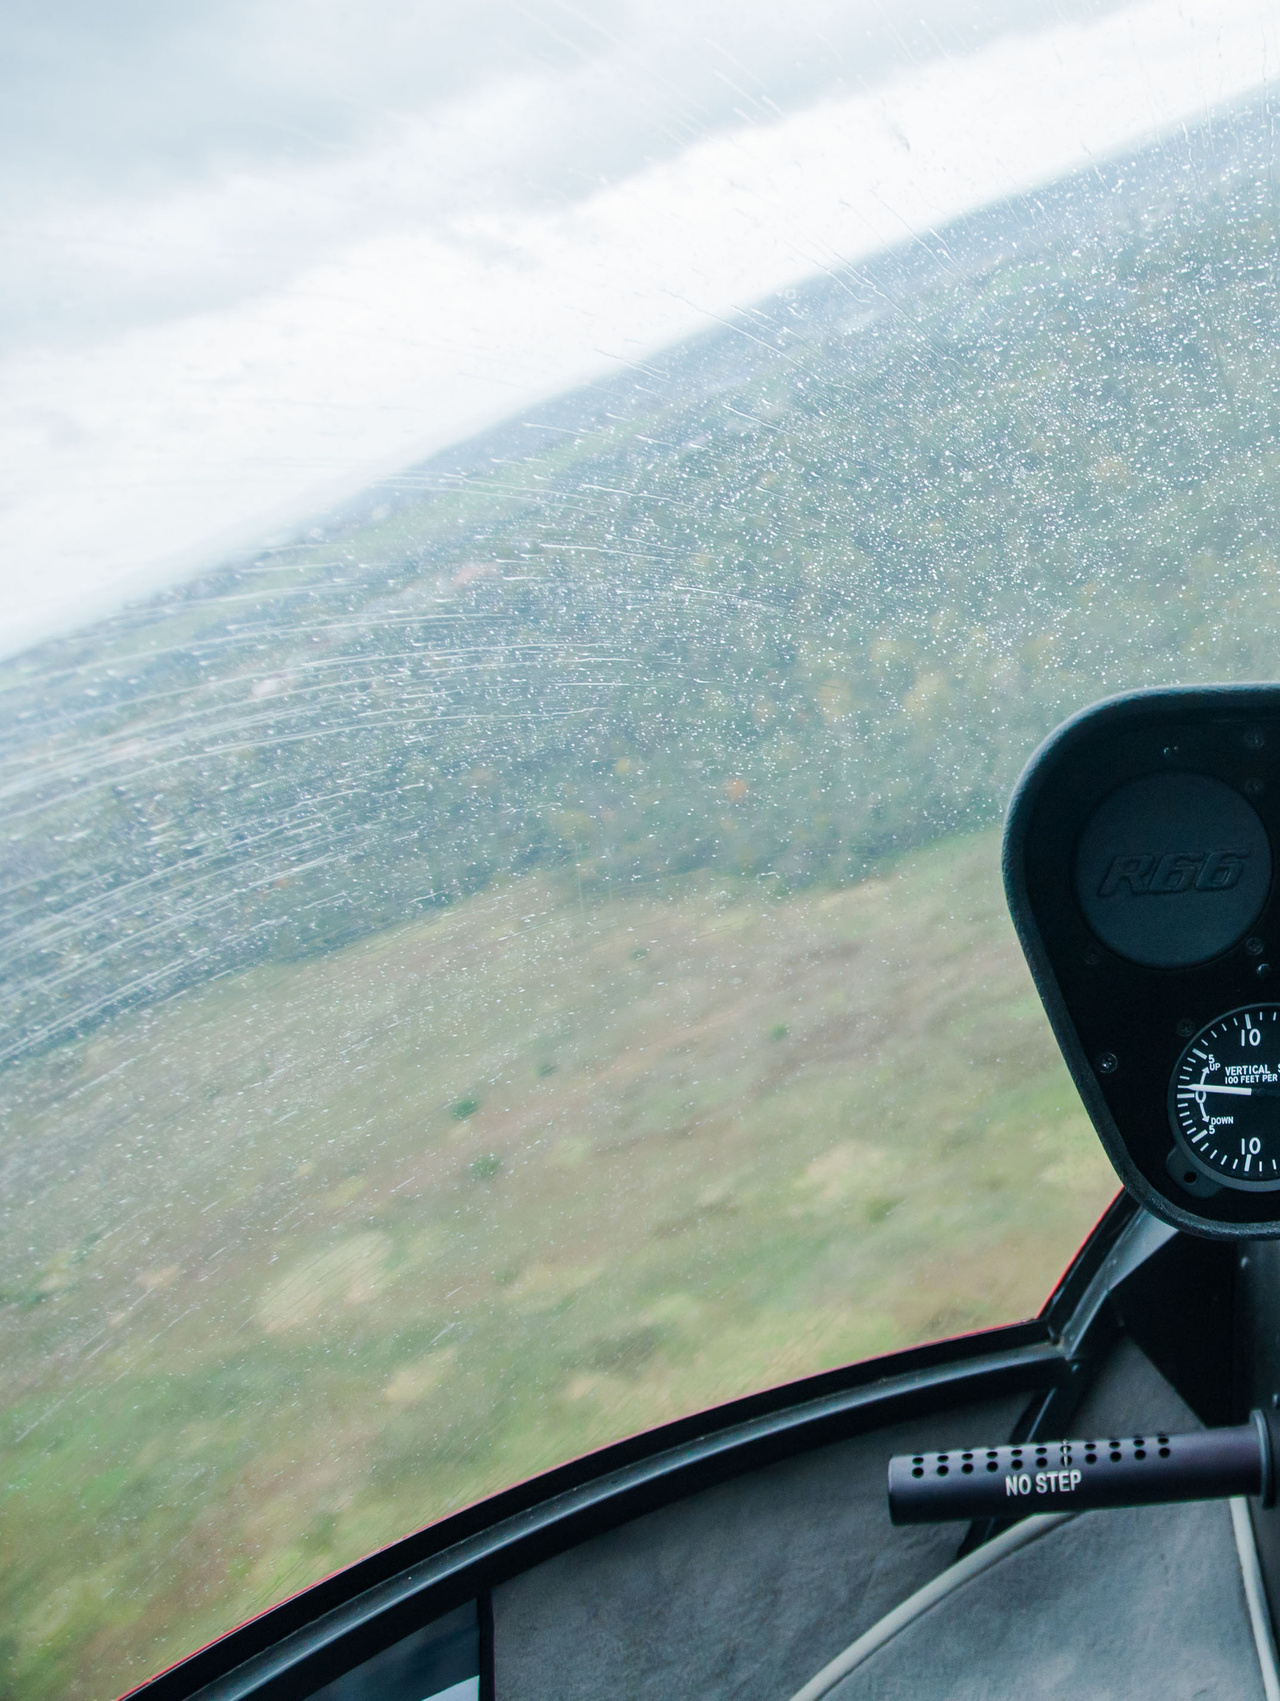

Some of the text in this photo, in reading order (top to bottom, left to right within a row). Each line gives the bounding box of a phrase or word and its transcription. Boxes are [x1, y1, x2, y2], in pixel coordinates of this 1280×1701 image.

[1097, 851, 1250, 898] R66
[1241, 1028, 1261, 1047] 10
[1208, 1054, 1215, 1064] 5
[1209, 1063, 1221, 1071] UP
[1225, 1065, 1270, 1076] VERTICAL
[1225, 1076, 1238, 1084] 100
[1241, 1075, 1260, 1084] FEET
[1262, 1074, 1277, 1082] PER
[1211, 1116, 1234, 1125] DOWN
[1209, 1125, 1215, 1135] 5
[1241, 1137, 1261, 1155] 10
[1005, 1469, 1081, 1496] NO STEP
